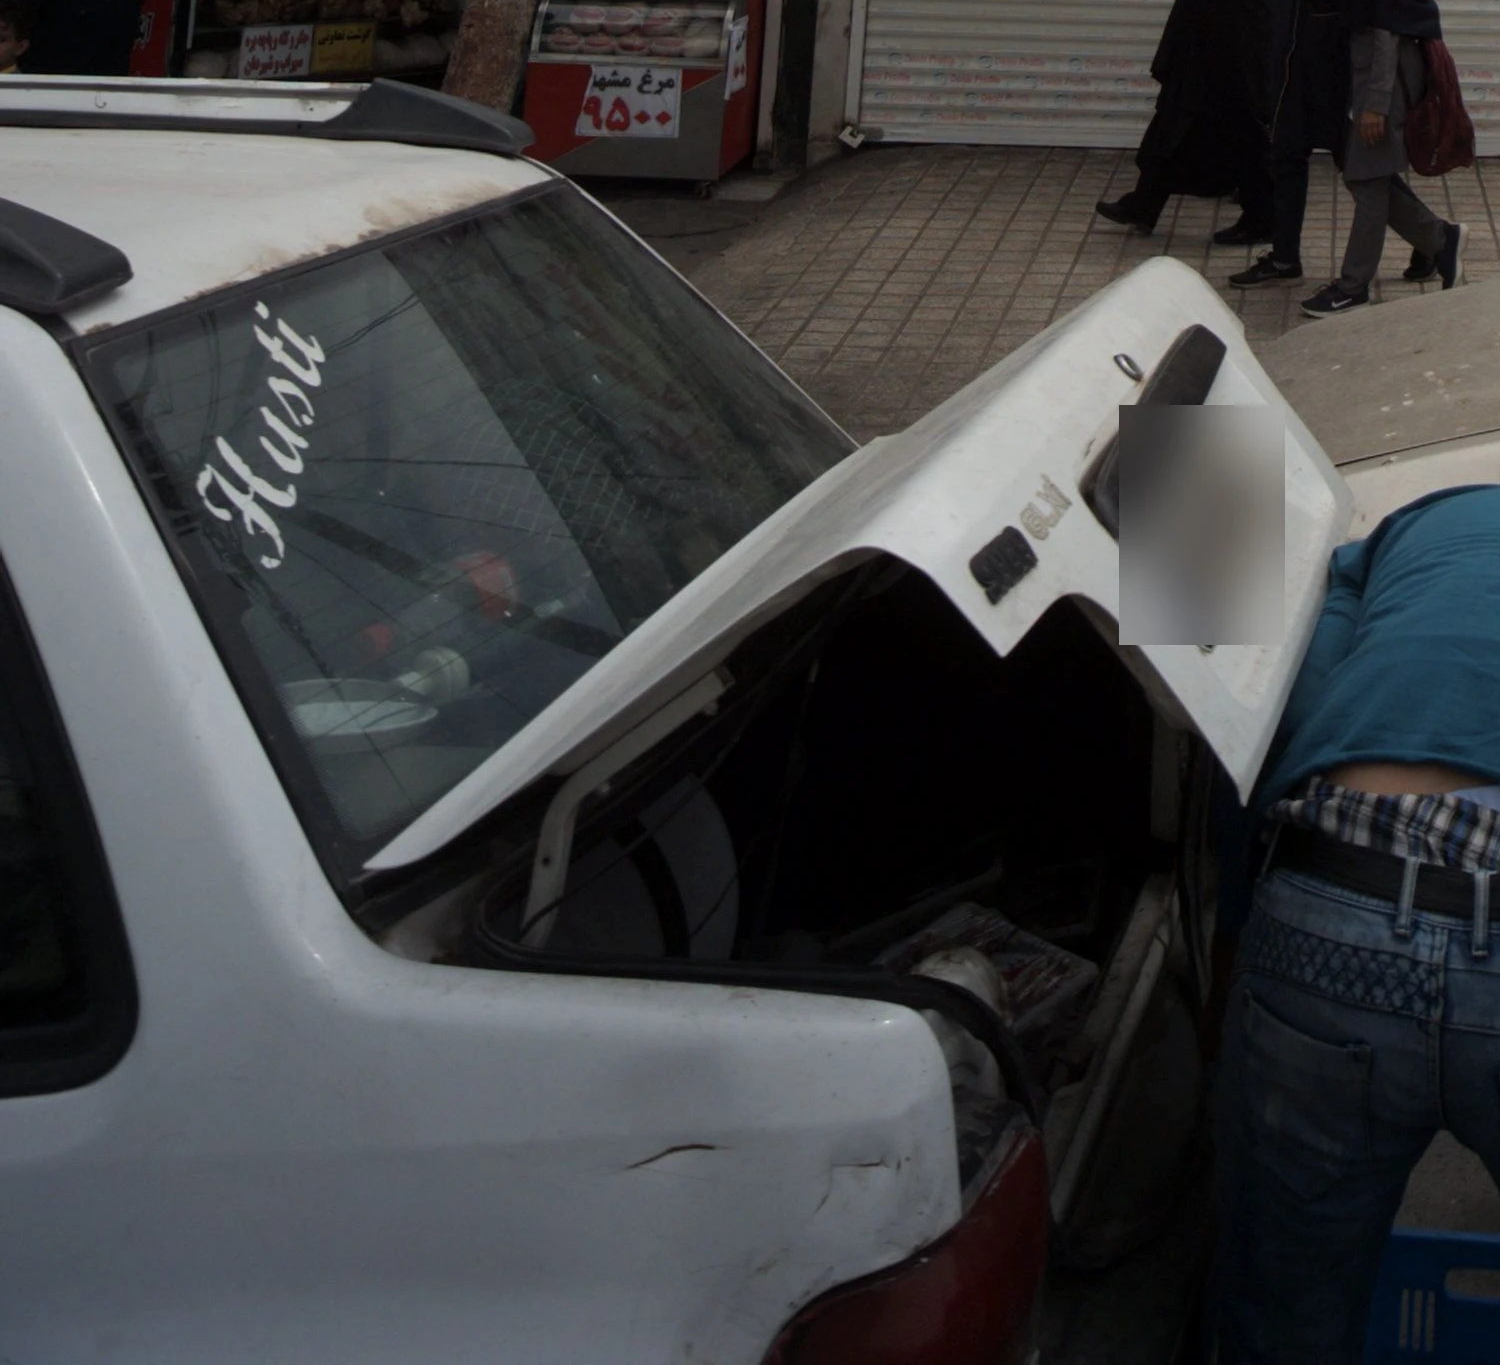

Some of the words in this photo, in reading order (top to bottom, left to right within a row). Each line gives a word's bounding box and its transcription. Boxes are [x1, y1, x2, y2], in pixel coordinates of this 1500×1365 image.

[636, 68, 676, 95] مرغ
[583, 95, 673, 132] ۹۵۰۰
[193, 299, 330, 572] Husti
